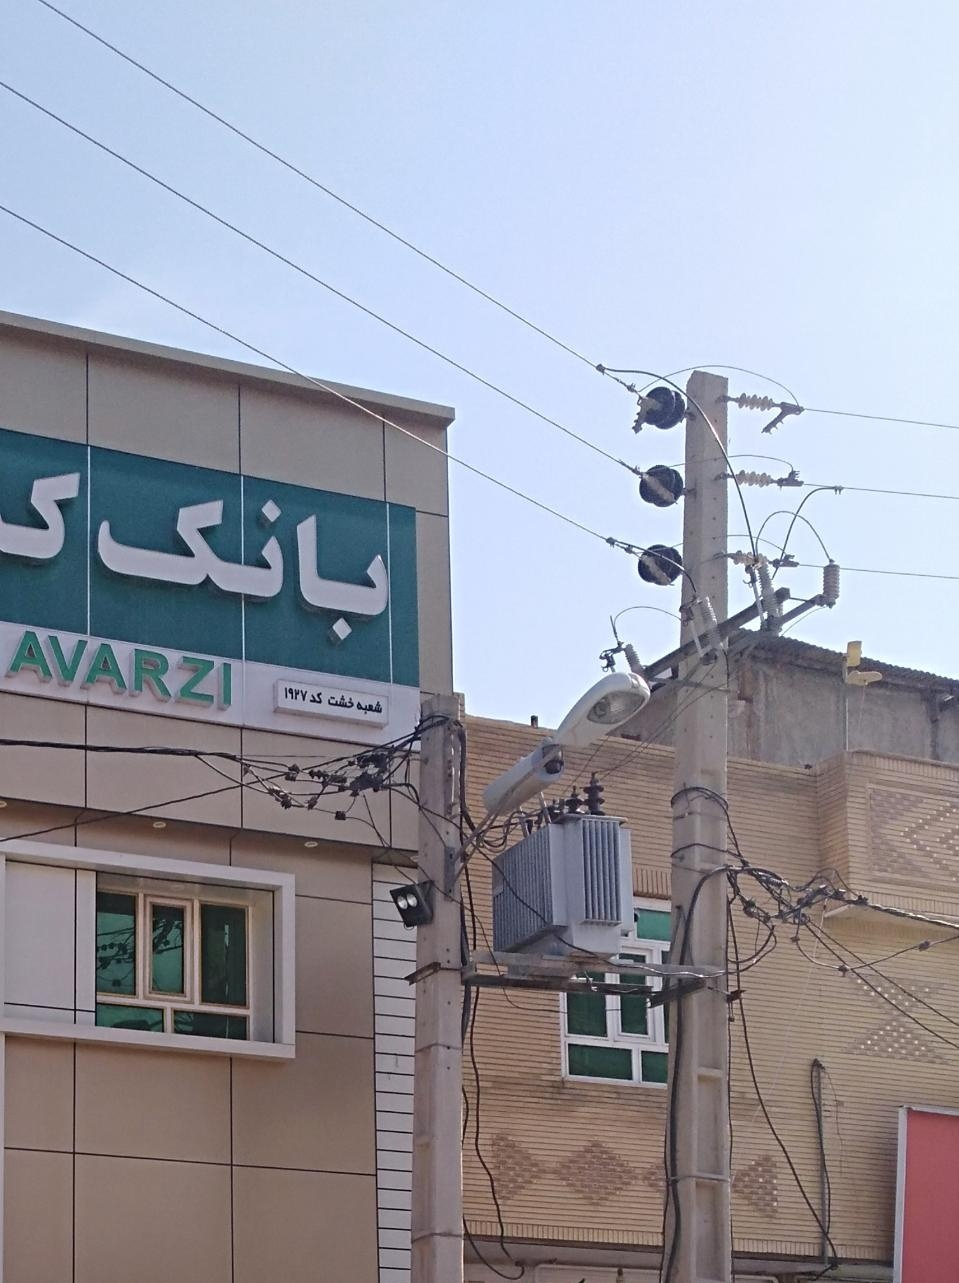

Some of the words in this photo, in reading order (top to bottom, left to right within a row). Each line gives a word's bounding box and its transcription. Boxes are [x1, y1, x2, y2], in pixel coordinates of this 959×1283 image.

[97, 499, 389, 641] بانک
[284, 687, 308, 702] ۱۹۲۷
[309, 691, 323, 705] کد
[327, 694, 355, 709] خشت
[356, 700, 384, 715] شعبه
